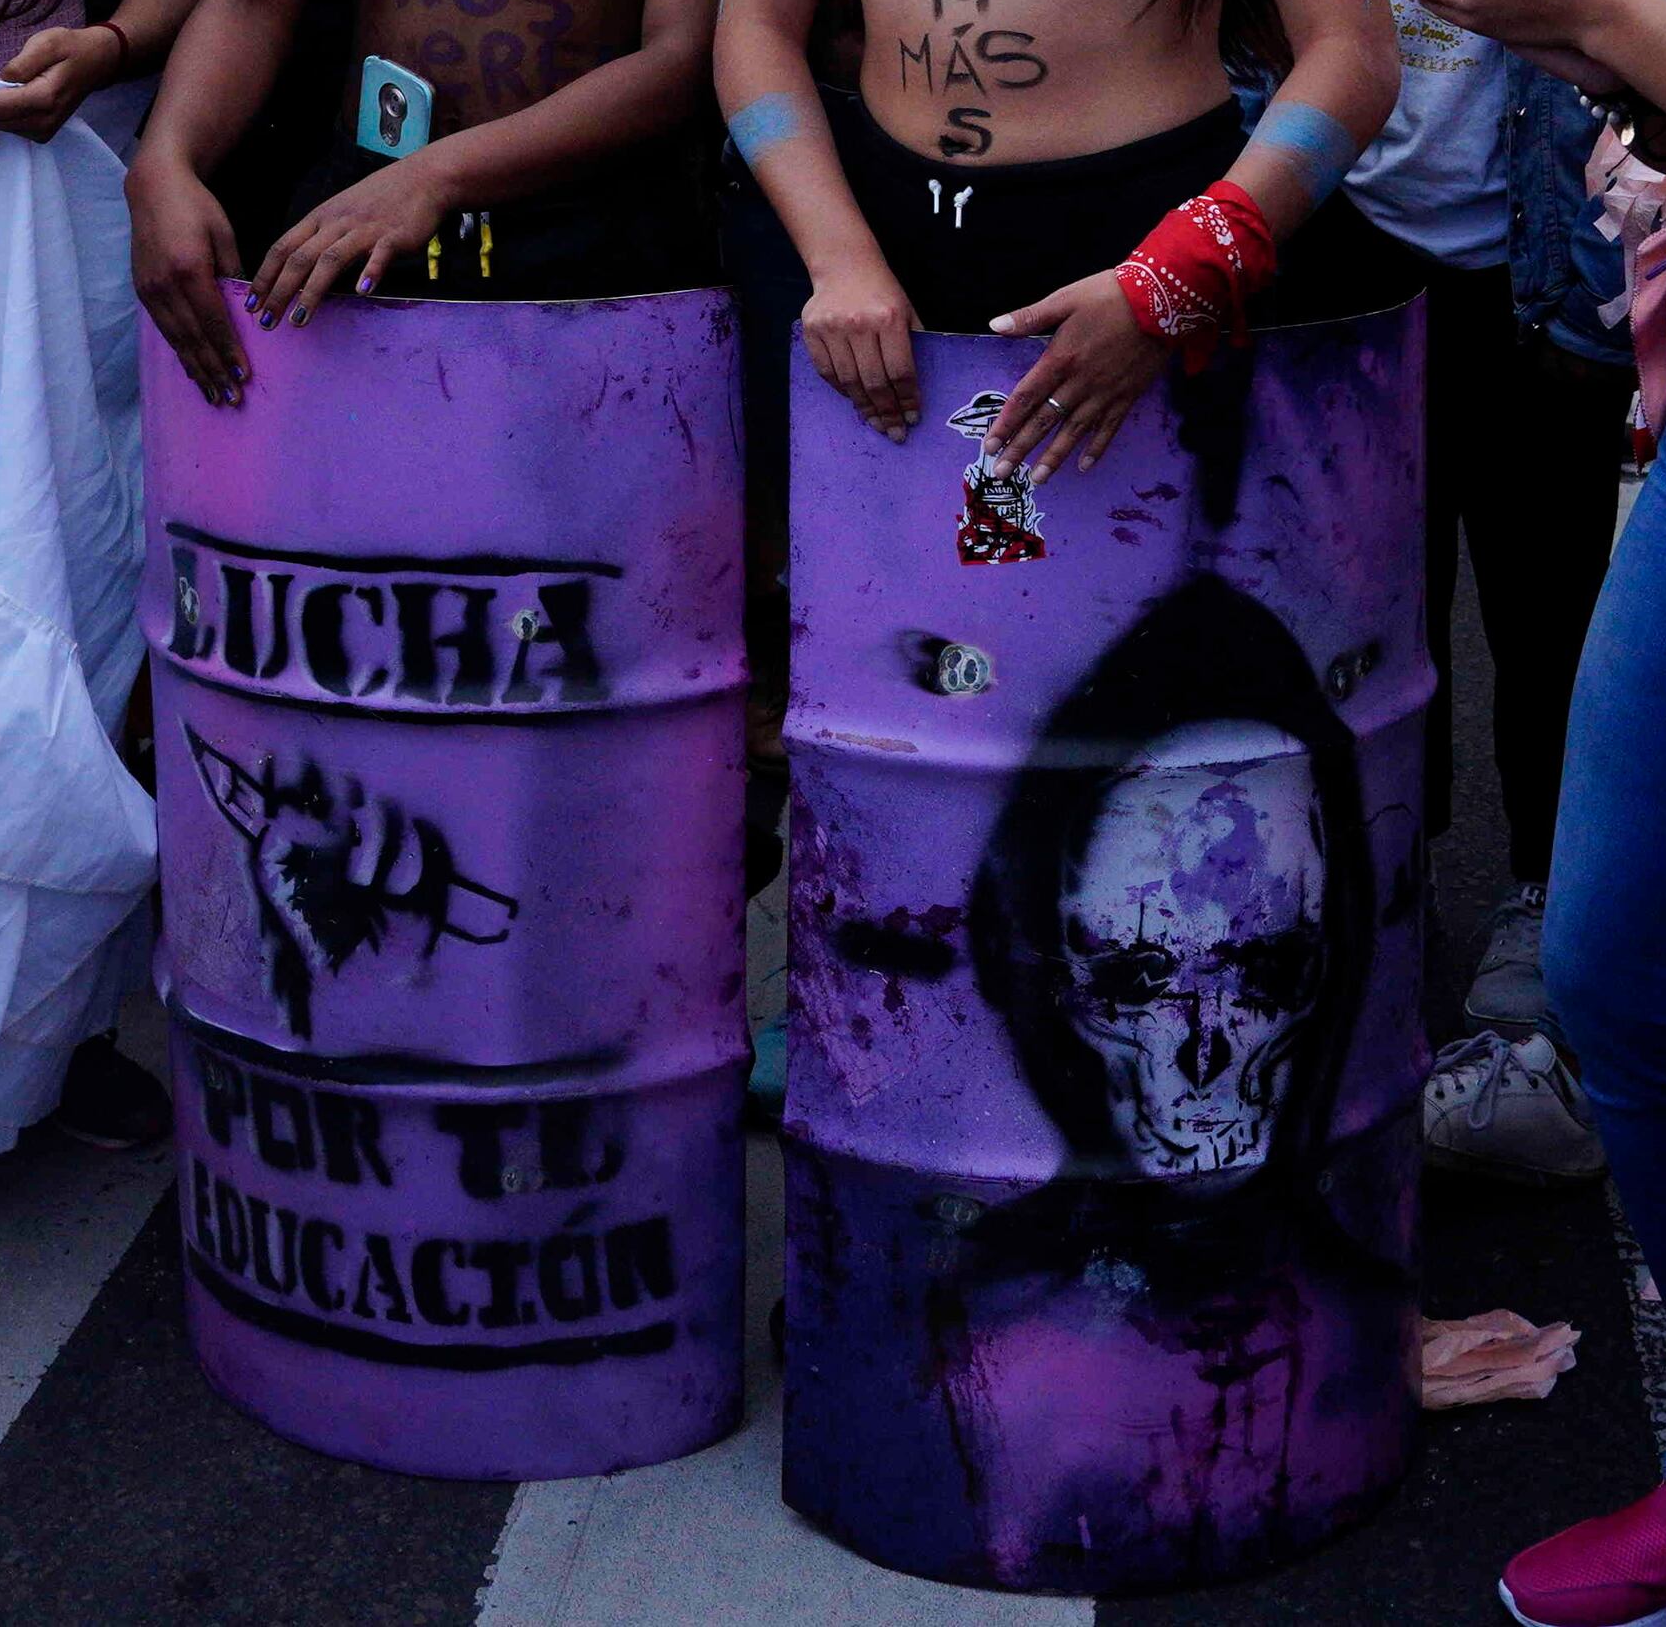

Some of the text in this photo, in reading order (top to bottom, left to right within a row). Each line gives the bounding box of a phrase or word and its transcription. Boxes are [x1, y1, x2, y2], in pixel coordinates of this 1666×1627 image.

[896, 22, 1049, 97] MÁS
[169, 545, 612, 706] LUCHA
[193, 1045, 393, 1187] POR
[191, 1157, 678, 1328] EDUCACIÓN
